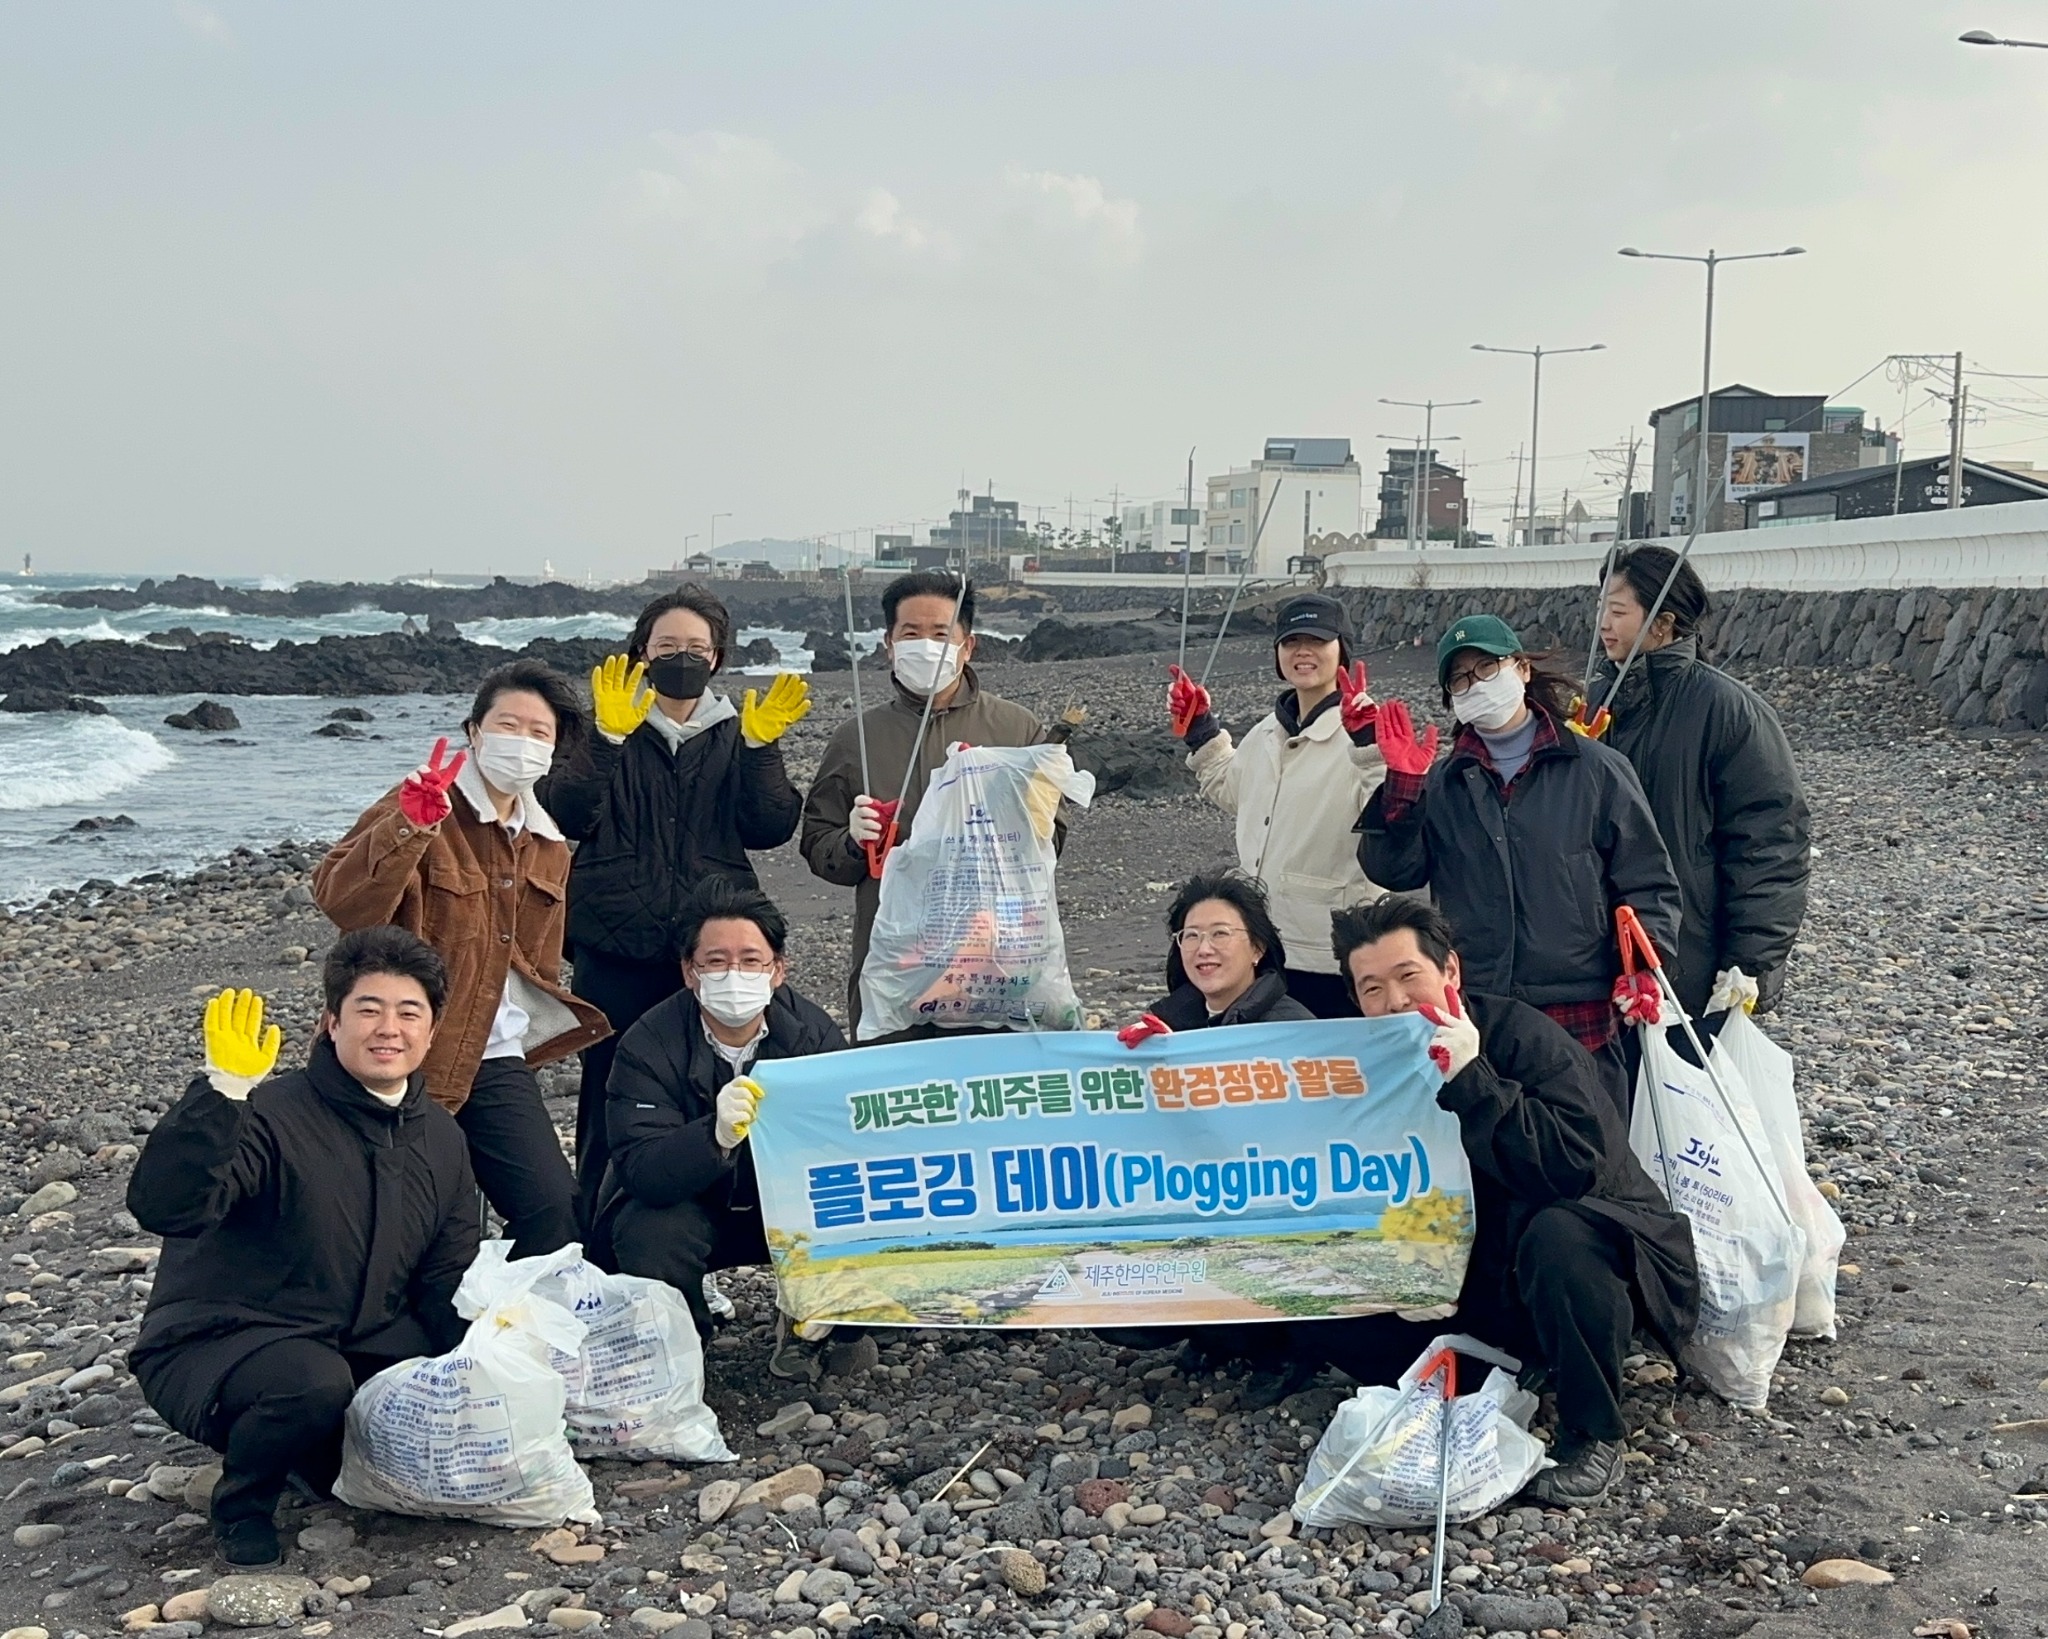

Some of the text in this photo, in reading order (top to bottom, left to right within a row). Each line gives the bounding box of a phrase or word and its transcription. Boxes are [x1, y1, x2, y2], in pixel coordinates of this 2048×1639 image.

[850, 1059, 1366, 1131] 깨끗한 제주를 위한 환경정화 활동
[808, 1152, 978, 1229] 플로깅
[1329, 1135, 1431, 1203] Day)
[1084, 1259, 1206, 1288] 제주한의약연구원
